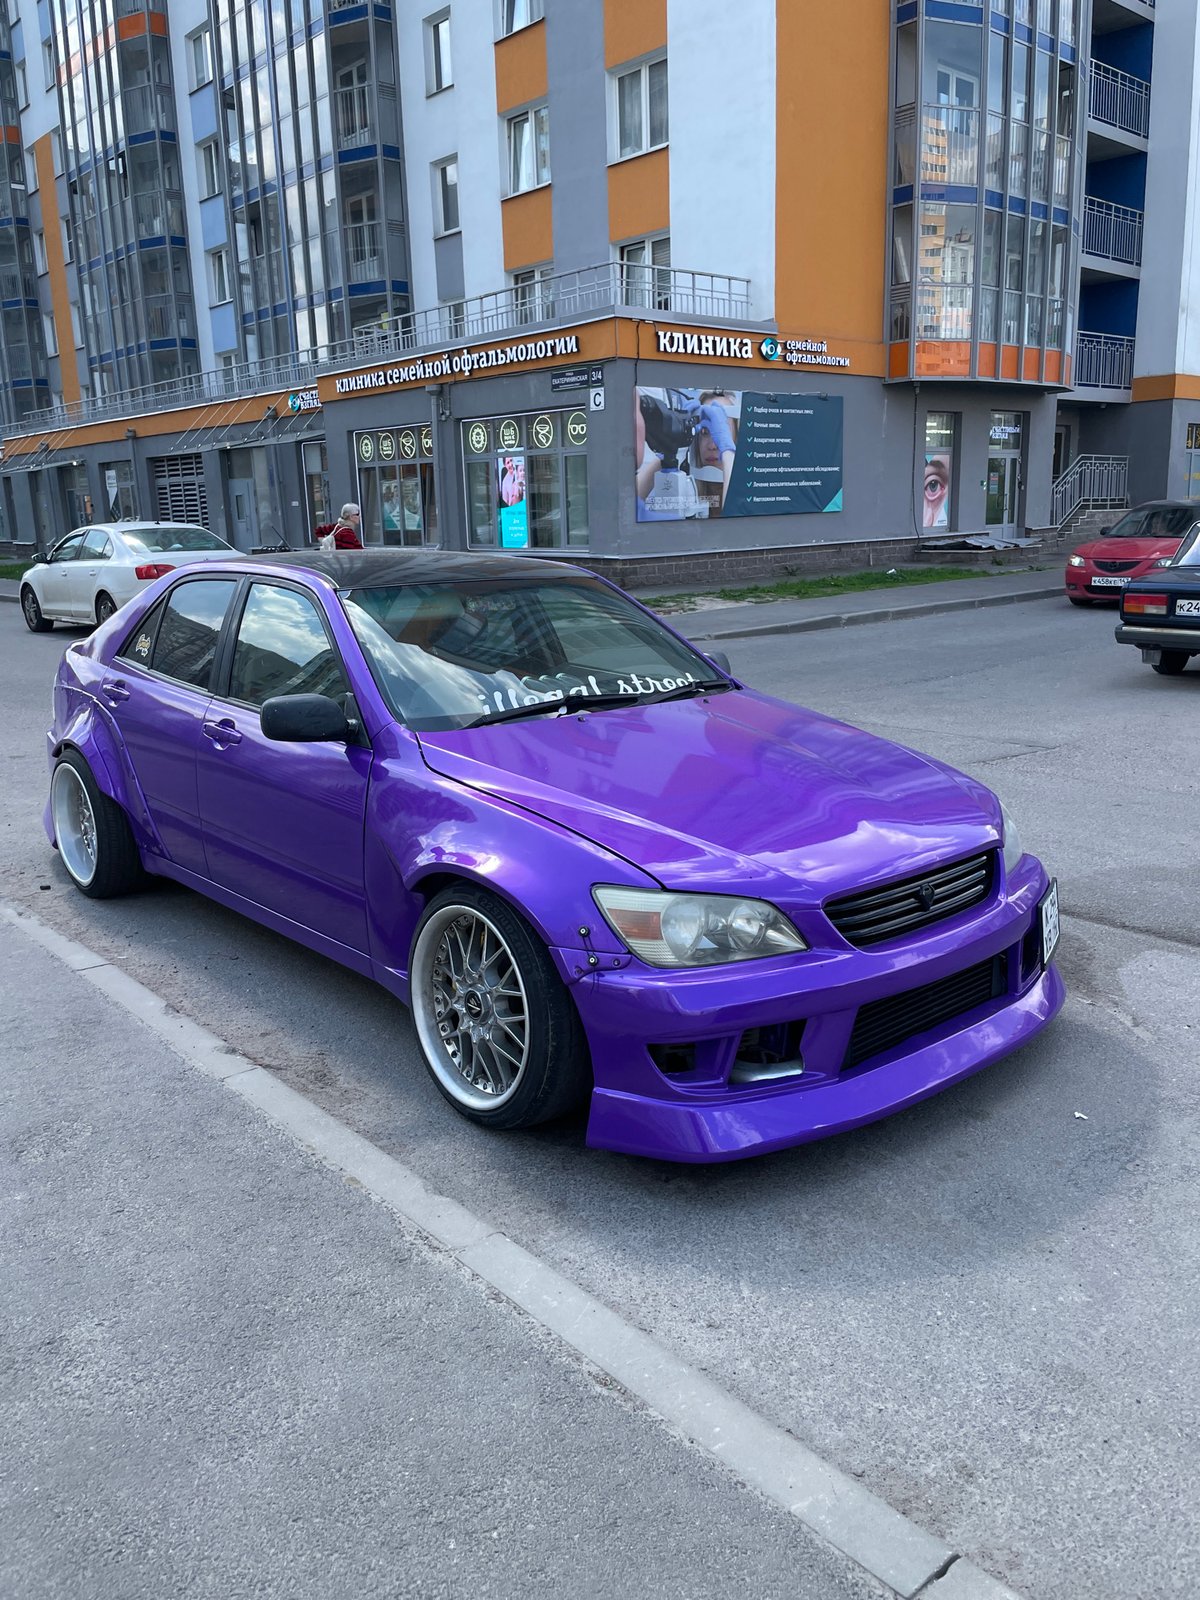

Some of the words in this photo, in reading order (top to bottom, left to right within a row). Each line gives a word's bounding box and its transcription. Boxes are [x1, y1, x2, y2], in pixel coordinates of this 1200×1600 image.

[657, 330, 753, 359] клиника
[785, 339, 828, 353] семейной
[335, 370, 386, 394] клиника
[386, 353, 452, 386] семейной
[452, 335, 579, 377] офтальмологии
[785, 352, 850, 367] офтальмологии
[552, 374, 588, 385] ЕКАТЕРИНИНСКАЯ
[591, 371, 602, 381] 3/4
